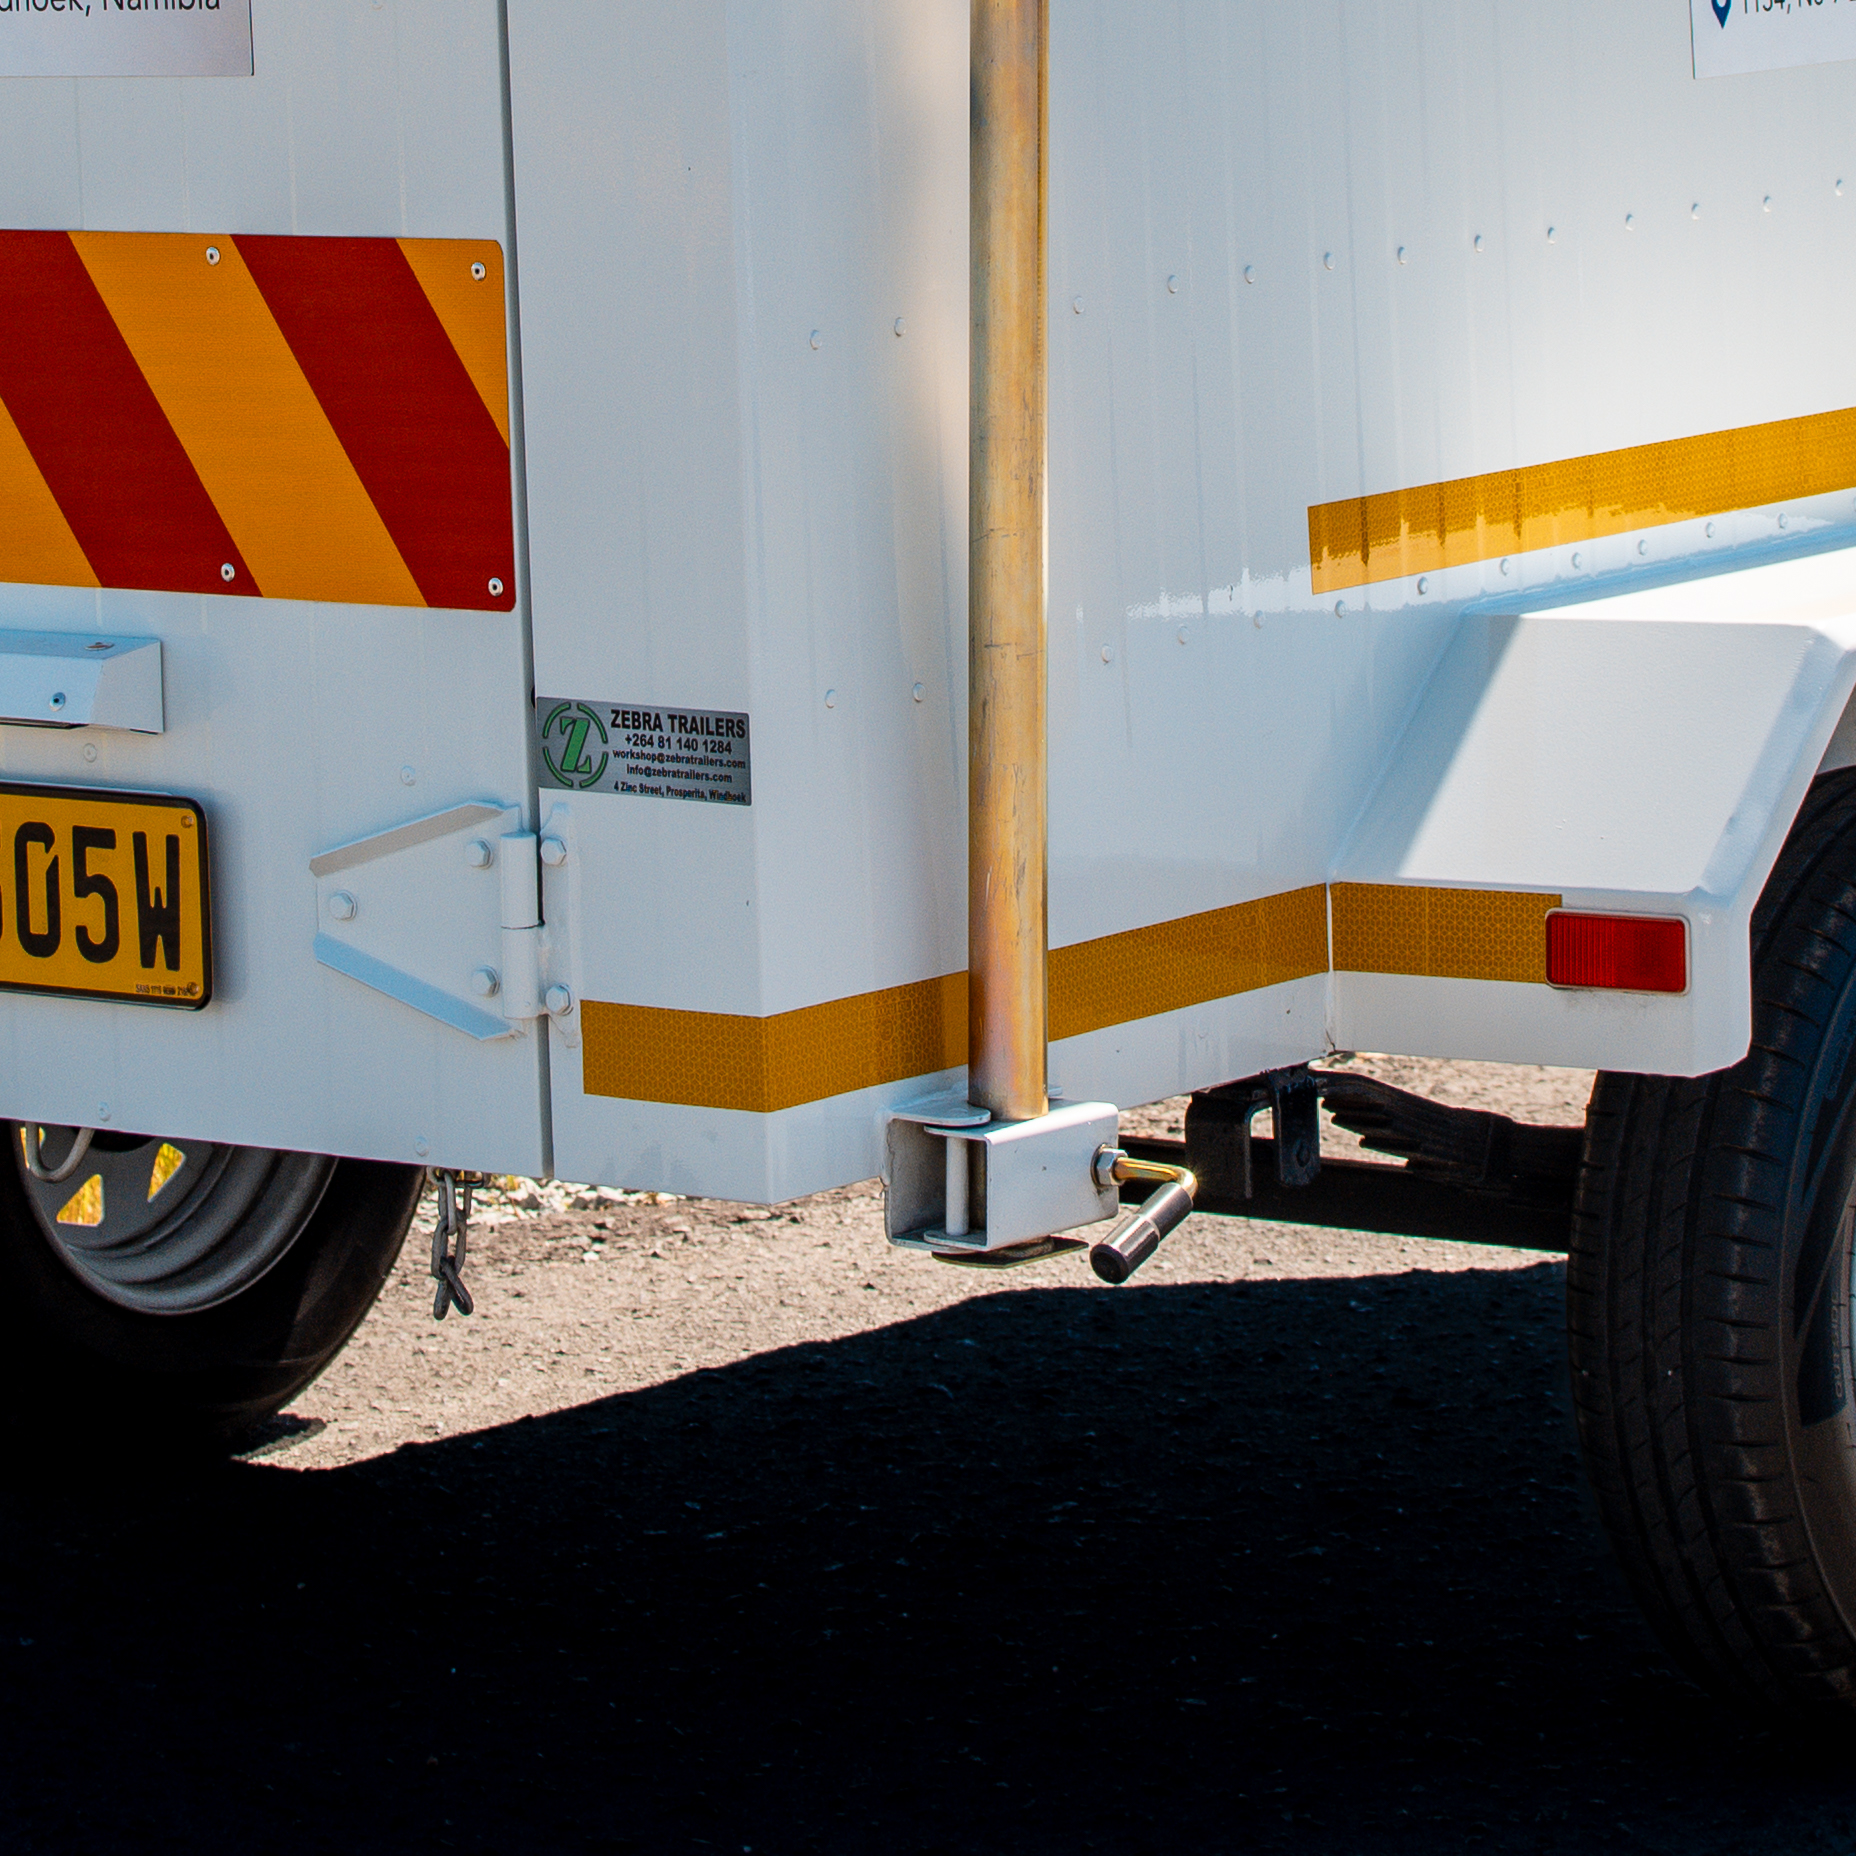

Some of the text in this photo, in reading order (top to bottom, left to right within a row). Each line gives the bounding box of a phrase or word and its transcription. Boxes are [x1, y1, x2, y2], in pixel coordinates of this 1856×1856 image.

[610, 709, 746, 738] ZEBRA TRAILERS
[625, 733, 732, 754] +264 81 140 1284
[613, 749, 746, 769] workshop@zebratrailers.com
